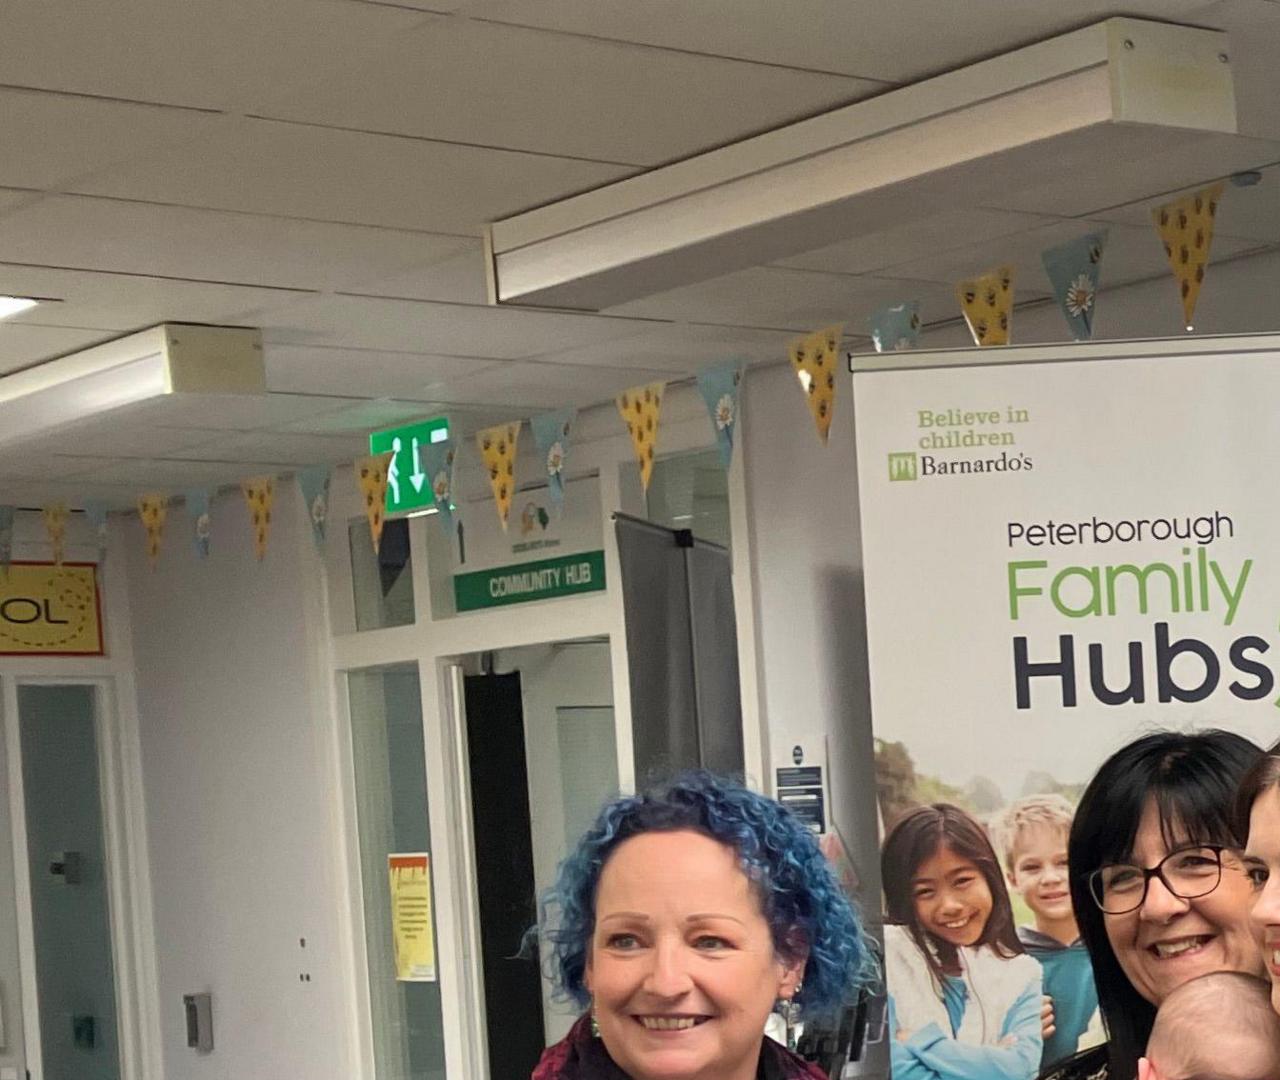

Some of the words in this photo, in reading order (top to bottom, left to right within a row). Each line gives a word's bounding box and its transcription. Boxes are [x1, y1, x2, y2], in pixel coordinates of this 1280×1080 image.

[918, 407, 1002, 429] Believe
[1006, 405, 1030, 424] in
[919, 428, 1016, 449] children
[921, 453, 1033, 477] Barnardo's
[1008, 511, 1235, 549] Peterborough
[490, 567, 561, 598] COMMUNITY
[565, 562, 592, 585] HUB
[1008, 547, 1253, 626] Family
[1012, 623, 1275, 710] Hubs
